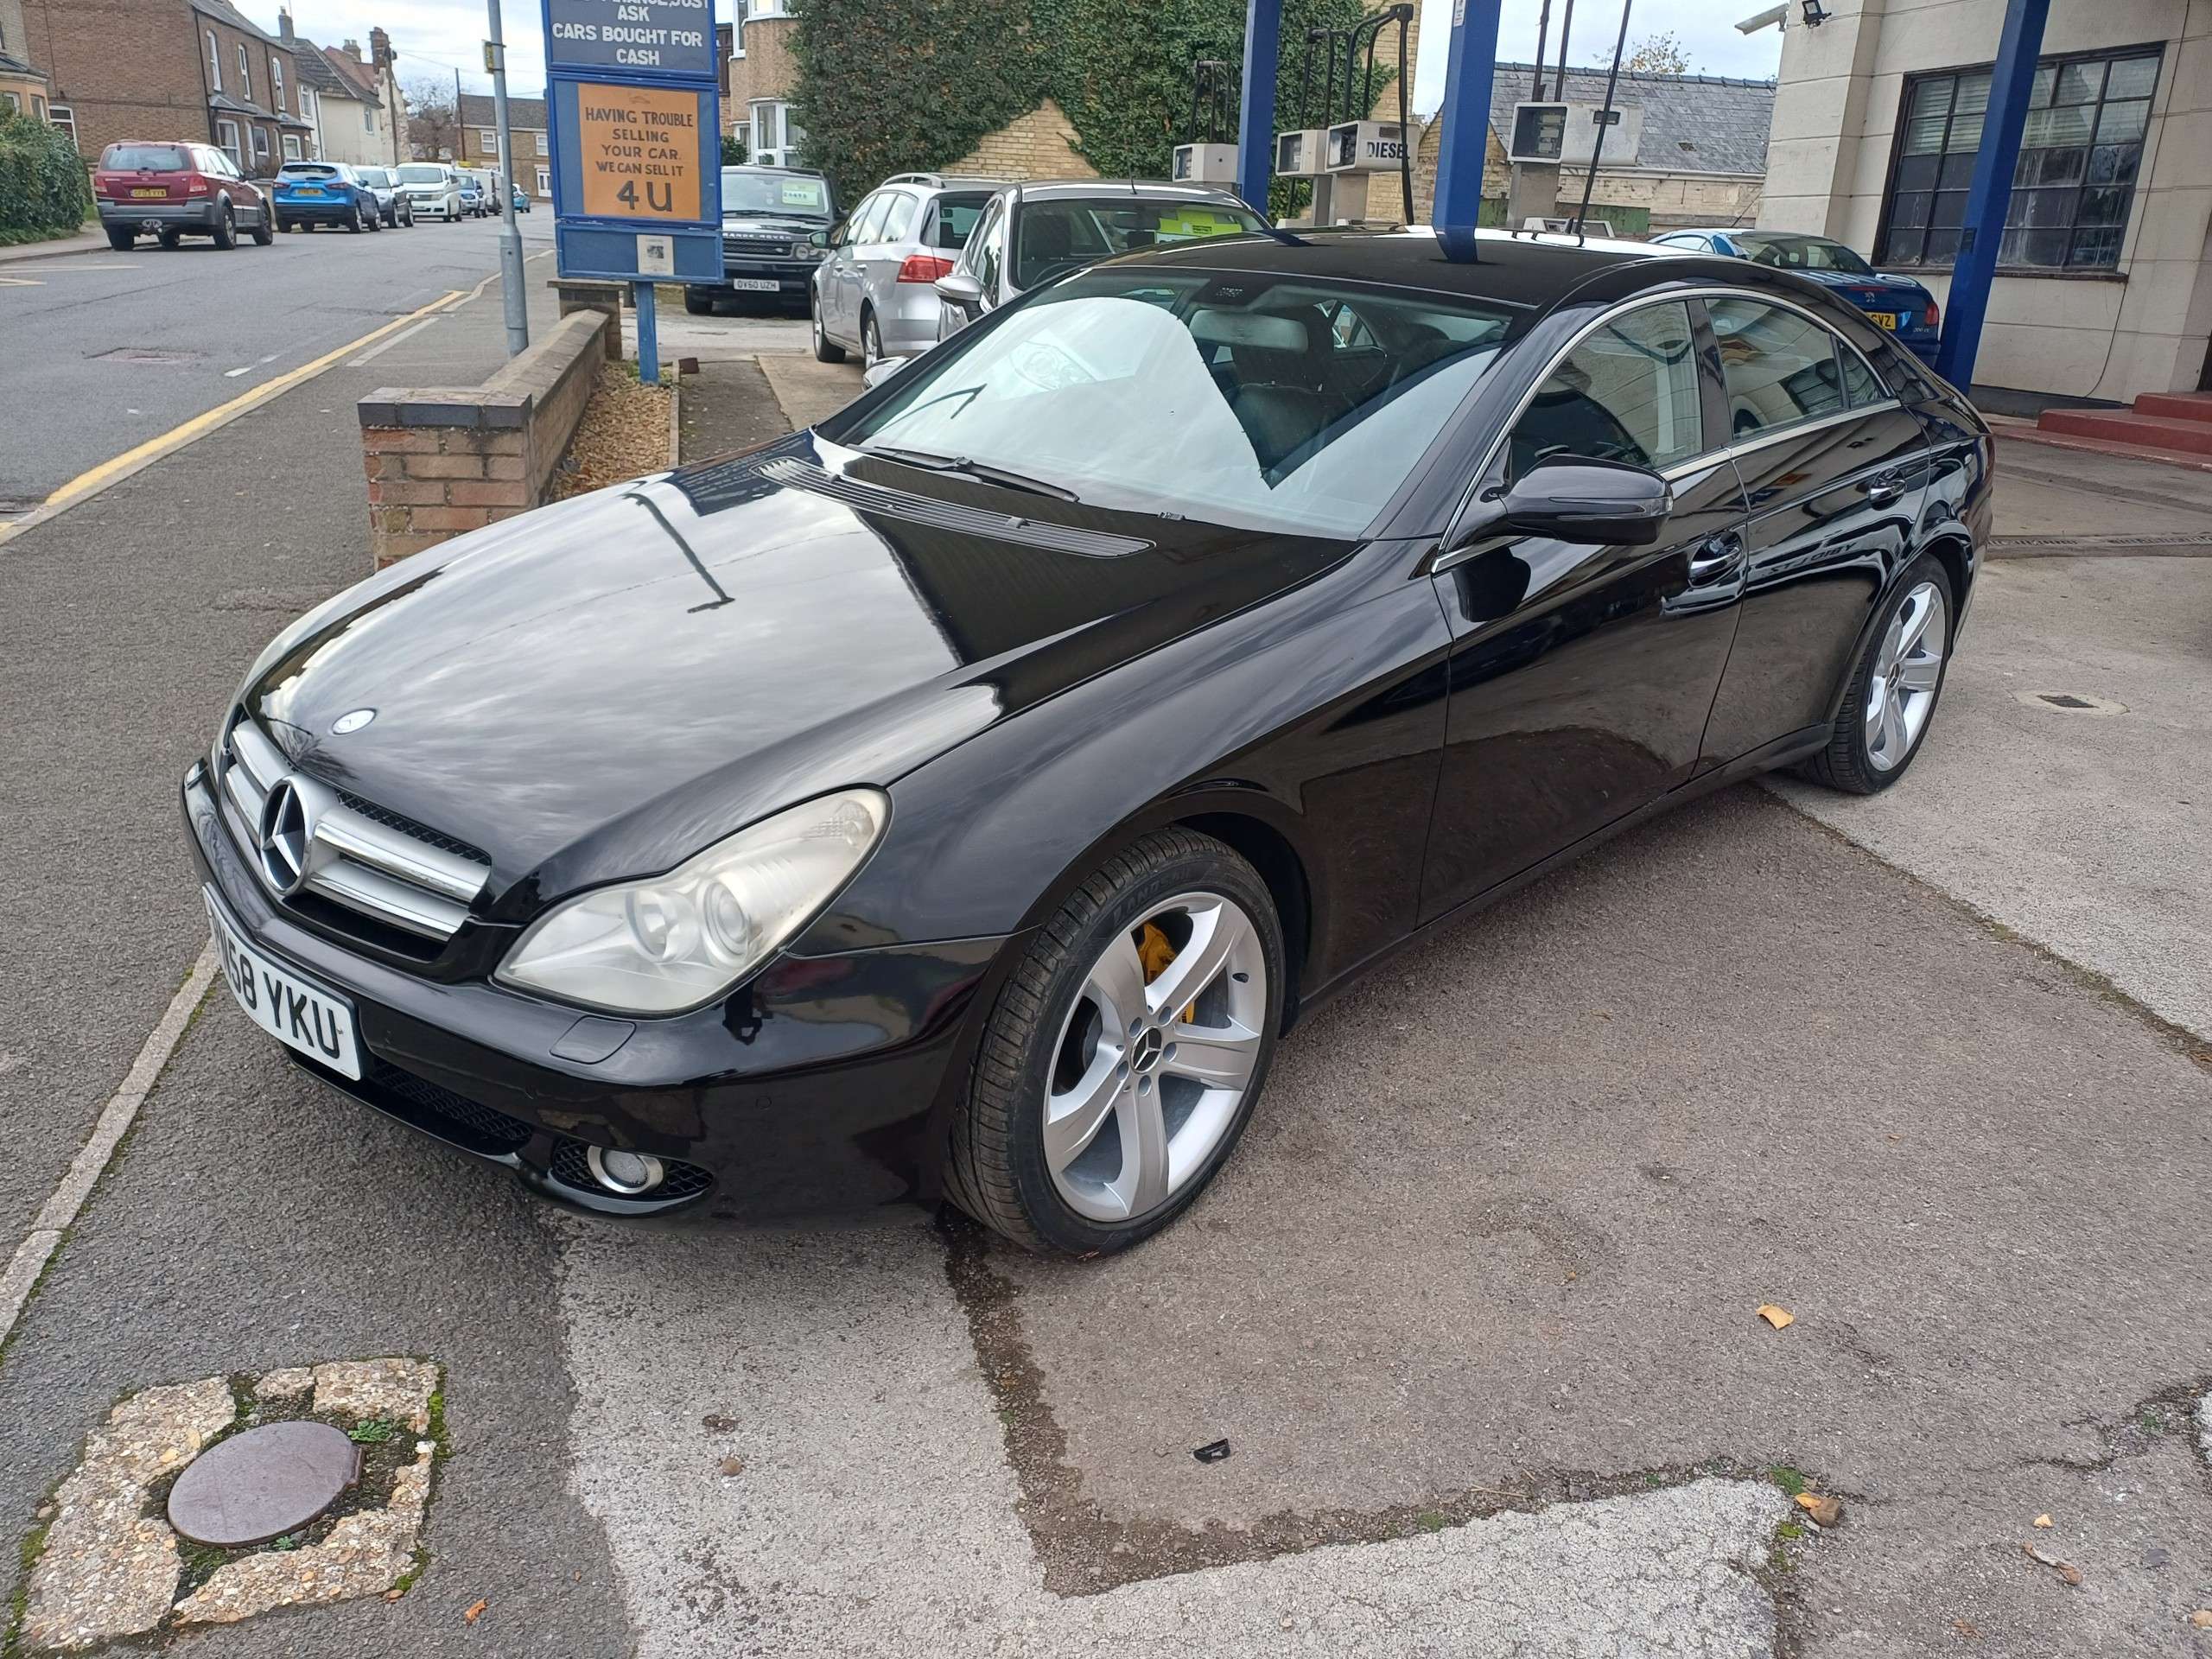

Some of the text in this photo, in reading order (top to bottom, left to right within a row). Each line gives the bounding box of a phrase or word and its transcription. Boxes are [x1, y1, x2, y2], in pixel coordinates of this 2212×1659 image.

[617, 5, 650, 22] ASK
[552, 22, 702, 47] CARS BOUGHT FOR
[616, 48, 660, 66] CASH
[585, 107, 693, 127] HAVING TROUBLE
[612, 129, 669, 143] SELLING
[601, 144, 642, 158] YOUR
[595, 161, 684, 176] WE CAN SELL IT
[616, 180, 672, 212] 4 U
[263, 971, 340, 1059] YKU
